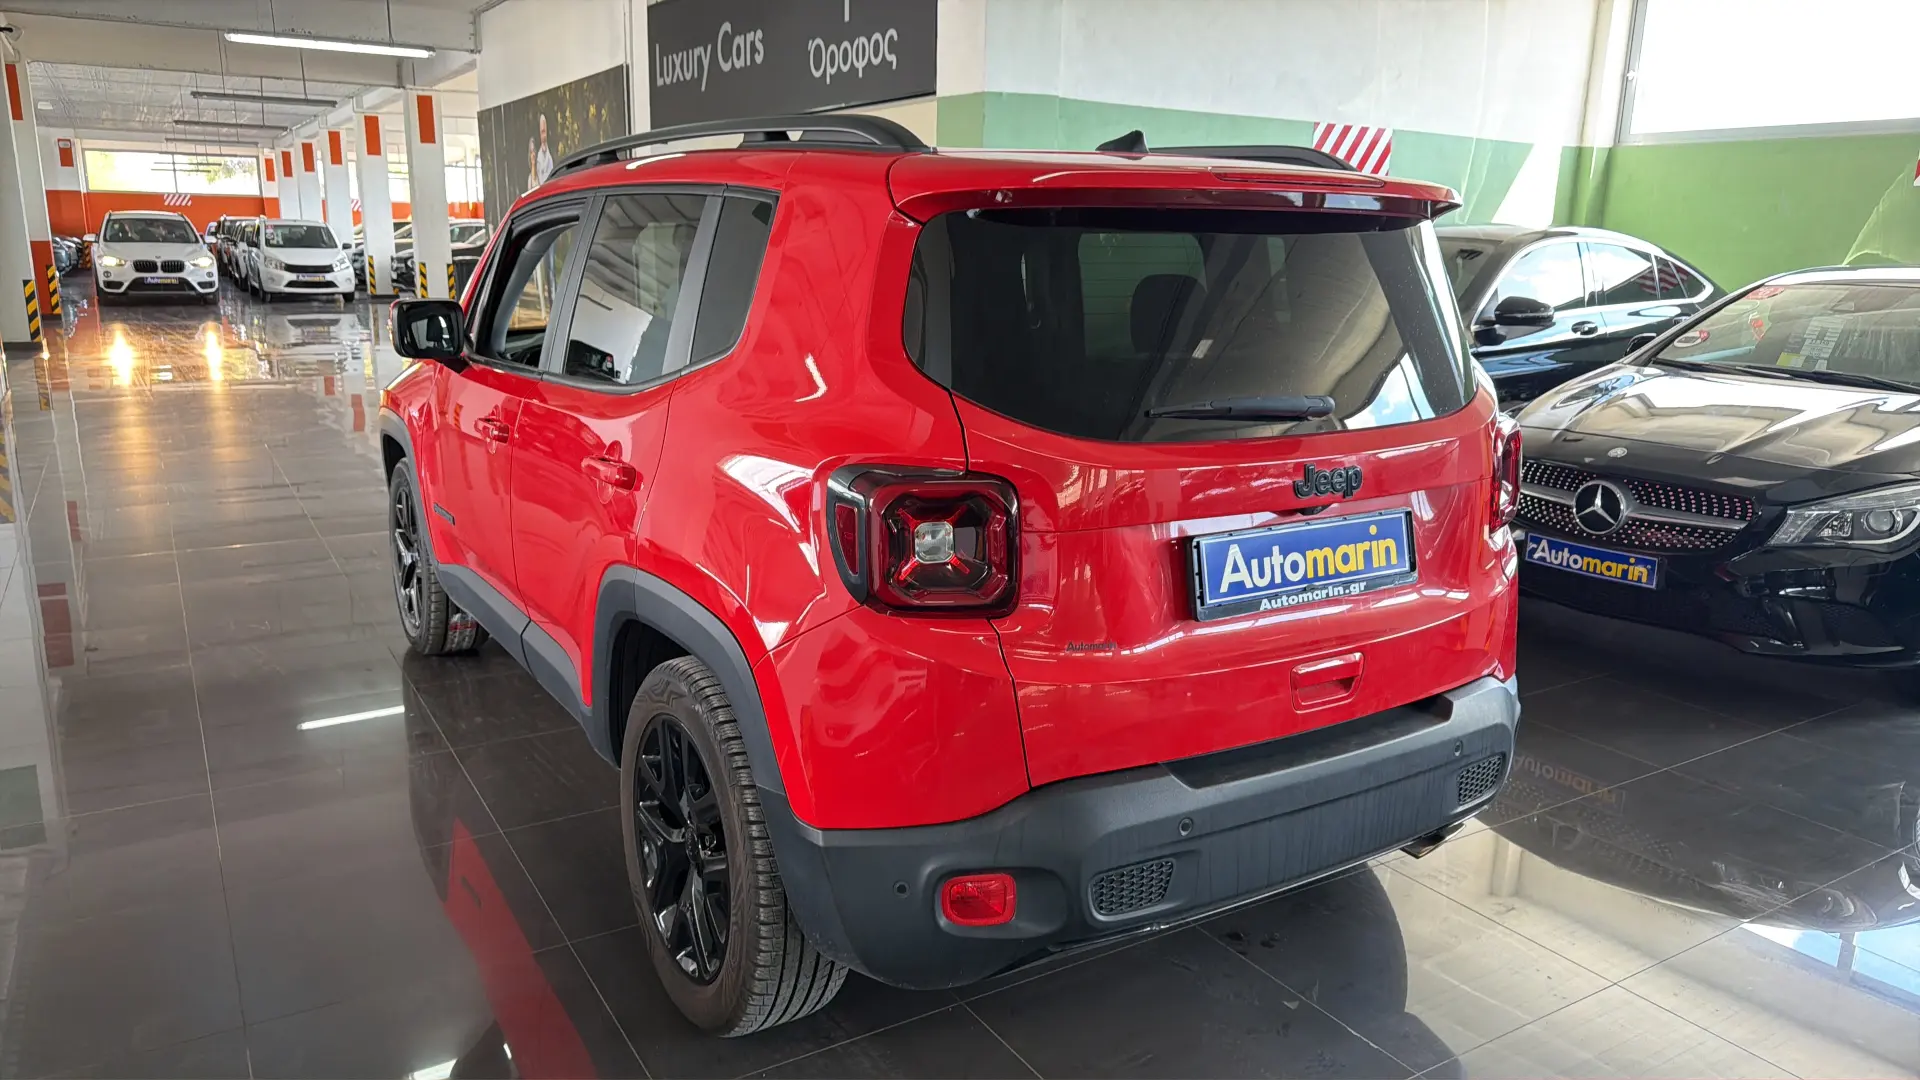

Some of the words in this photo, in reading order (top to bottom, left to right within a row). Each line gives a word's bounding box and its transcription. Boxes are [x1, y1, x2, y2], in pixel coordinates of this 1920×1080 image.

[655, 43, 711, 92] Luxury
[717, 21, 764, 72] Cars
[808, 28, 898, 85] Όροφος
[1294, 463, 1363, 499] Jeep
[1219, 524, 1398, 593] Automarin
[1532, 539, 1648, 583] Automarin
[1259, 580, 1367, 611] Automarin.gr
